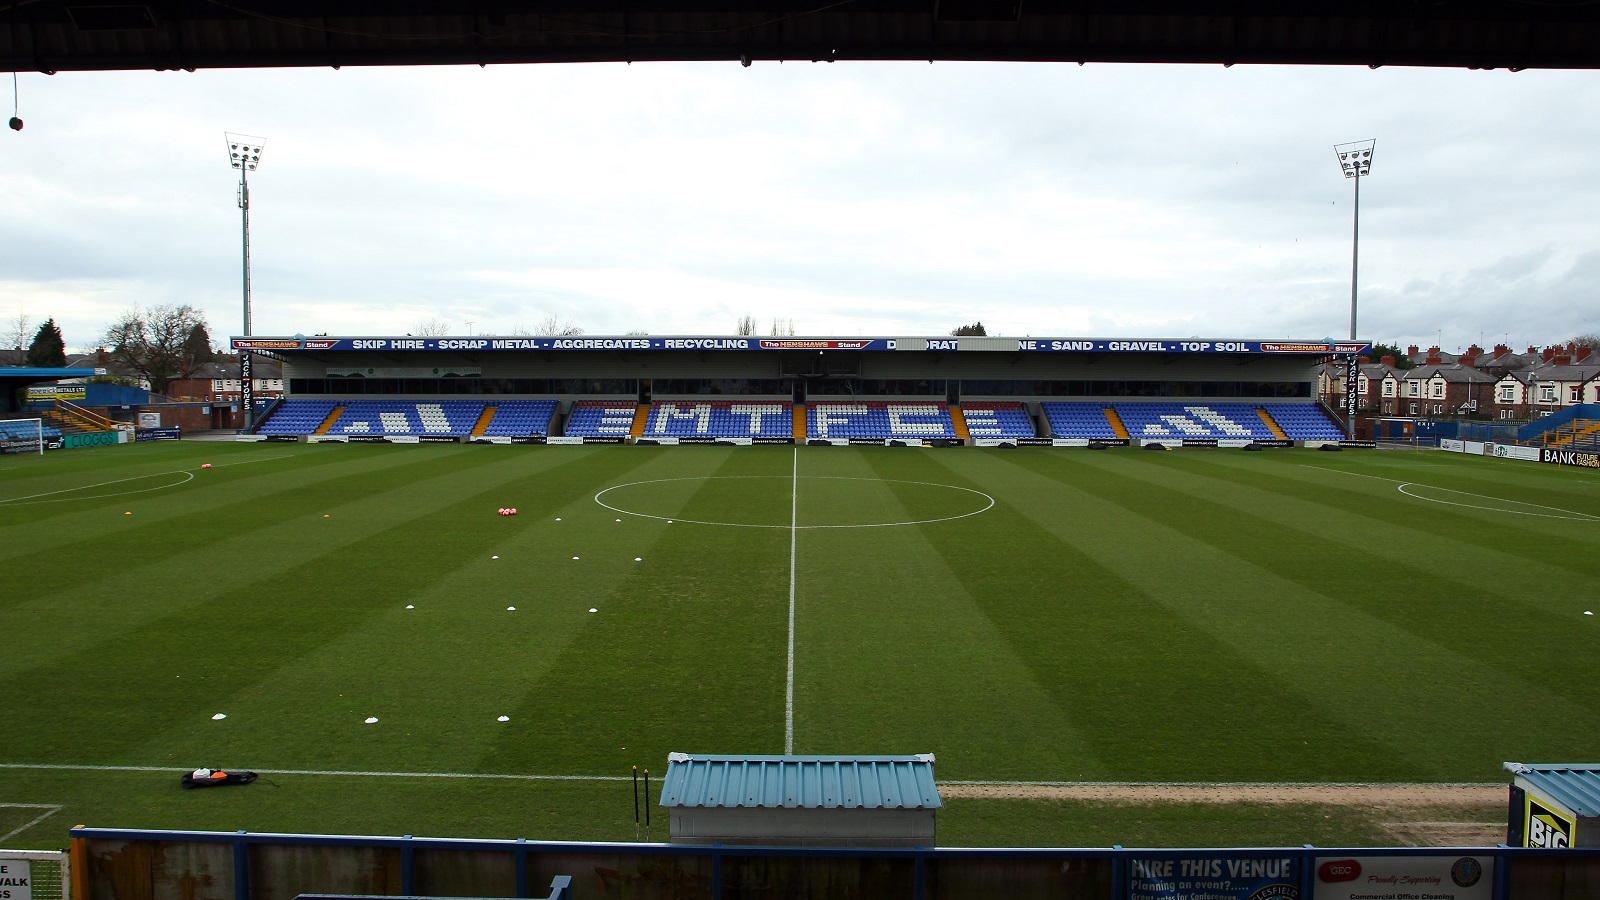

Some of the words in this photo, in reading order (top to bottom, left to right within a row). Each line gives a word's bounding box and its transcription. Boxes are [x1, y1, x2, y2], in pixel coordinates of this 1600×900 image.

[352, 340, 387, 349] SKIP
[391, 340, 425, 349] HIRE
[438, 340, 488, 349] SCRAP
[492, 340, 539, 349] METAL
[552, 340, 650, 349] AGGREGATES
[664, 340, 748, 349] RECYCLING
[1052, 341, 1094, 350] SAND
[1108, 342, 1166, 350] GRAVEL
[1180, 342, 1210, 351] TOP
[1214, 342, 1250, 352] SOIL
[72, 432, 114, 448] CLOGGS
[1544, 450, 1576, 465] BANK
[1576, 459, 1600, 468] FASHION
[1132, 860, 1174, 878] HIRE
[1180, 860, 1222, 878] THIS
[1226, 859, 1290, 878] VENUE
[1330, 866, 1352, 874] GEC
[1131, 880, 1176, 892] Planning
[1178, 881, 1192, 889] an
[1367, 875, 1399, 886] Proudly
[1399, 875, 1441, 886] Supporting
